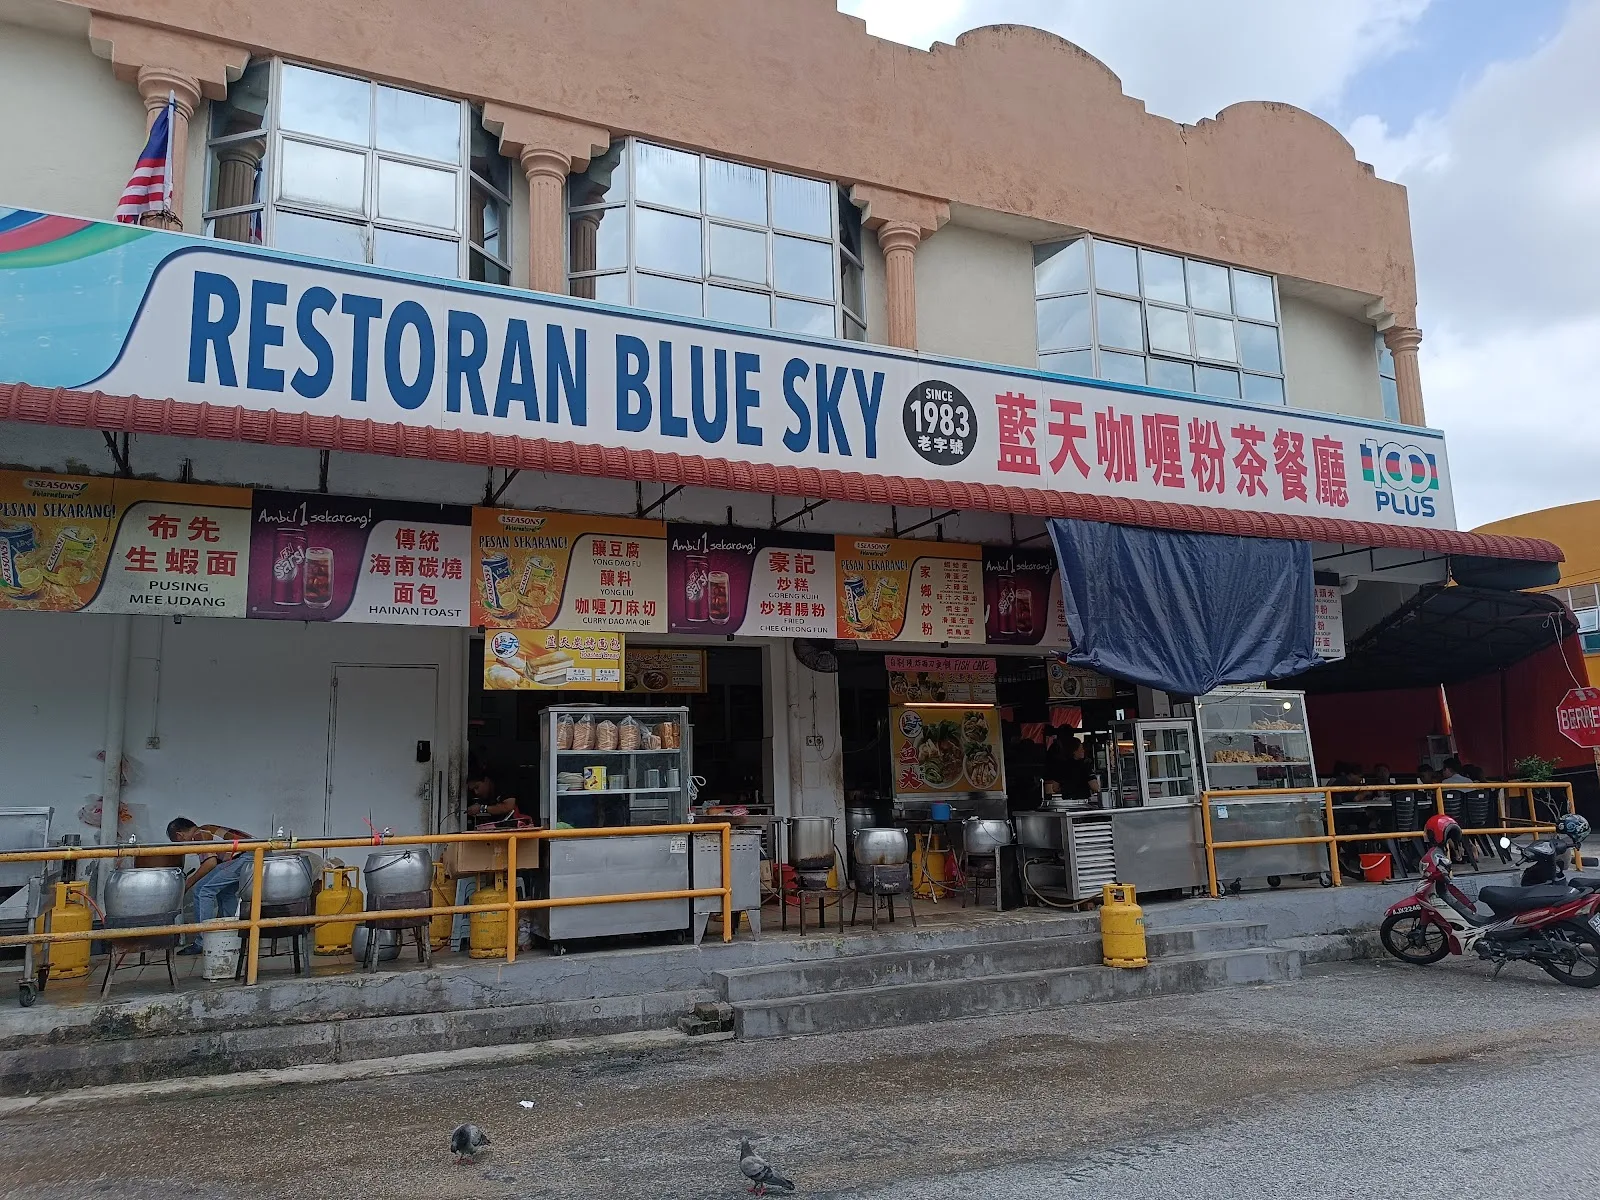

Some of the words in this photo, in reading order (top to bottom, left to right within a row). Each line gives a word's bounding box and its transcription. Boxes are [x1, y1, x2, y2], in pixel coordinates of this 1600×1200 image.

[189, 271, 588, 426] RESTORAN
[615, 334, 763, 446] BLUE
[782, 357, 885, 459] SKY
[926, 388, 953, 402] SINCE
[910, 400, 970, 438] 1983
[918, 435, 964, 455] 老字號
[996, 391, 1348, 508] 藍天咖喱粉茶餐廳
[1365, 438, 1431, 493] 100
[34, 480, 81, 491] SEASONS
[43, 503, 116, 518] SEKARANG!
[1376, 491, 1435, 517] PLUS
[258, 508, 298, 523] Ambil
[299, 501, 308, 526] 1
[310, 508, 372, 529] sekarang!
[506, 516, 540, 525] SEASONS
[147, 514, 220, 542] 布先
[395, 528, 439, 551] 傳統
[479, 535, 509, 548] PESAN
[514, 536, 568, 549] SEKARANG!
[672, 538, 701, 551] Ambil
[702, 532, 709, 554] 1
[710, 536, 756, 555] sekarang!
[125, 546, 238, 576] 生蝦面
[370, 554, 462, 579] 海南碳燒
[592, 558, 613, 566] YONG
[769, 552, 816, 575] 豪記
[841, 559, 864, 571] PESAN
[867, 560, 909, 571] SEKARANG!
[986, 560, 1008, 571] Ambil
[1009, 554, 1015, 574] 1
[1016, 558, 1052, 575] sekarang!
[149, 581, 209, 592] PUSING
[394, 582, 438, 604] 面包
[601, 588, 621, 596] YONG
[129, 595, 163, 605] MEE
[168, 596, 225, 607] UDANG
[768, 592, 800, 600] GORENG
[1056, 600, 1064, 608] 生
[369, 606, 419, 616] HAINAN
[421, 607, 462, 617] TOAST
[1057, 613, 1066, 623] 生
[582, 617, 607, 625] CURRY
[638, 619, 651, 627] QIE
[954, 659, 971, 671] FISH
[972, 660, 989, 671] CAKE
[1561, 706, 1600, 730] BERHE
